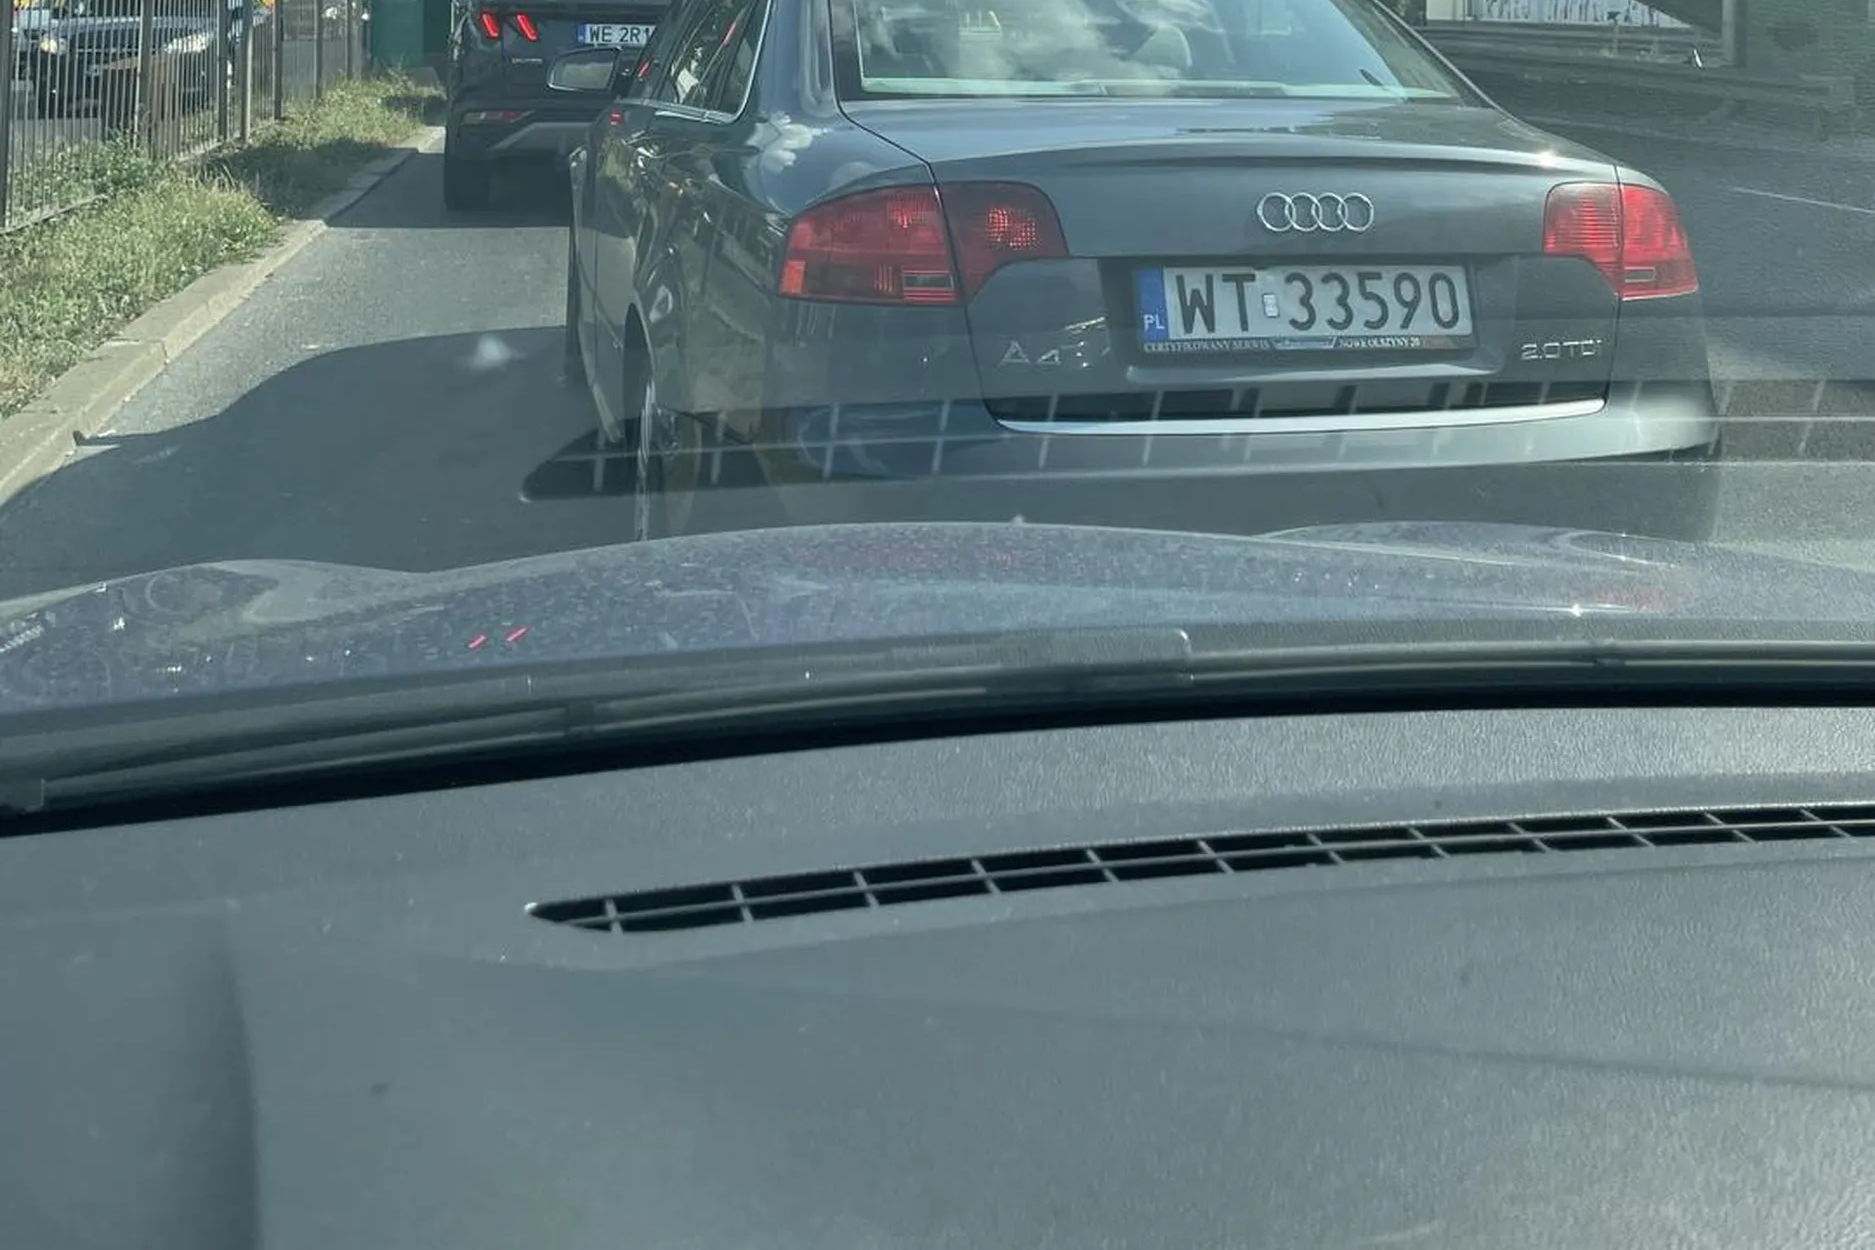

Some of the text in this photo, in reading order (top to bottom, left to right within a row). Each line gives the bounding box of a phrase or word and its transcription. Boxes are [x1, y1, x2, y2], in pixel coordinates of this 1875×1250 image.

[589, 26, 612, 42] WE
[1176, 272, 1460, 334] WT 33590
[1143, 314, 1165, 330] PL
[998, 340, 1062, 367] A4
